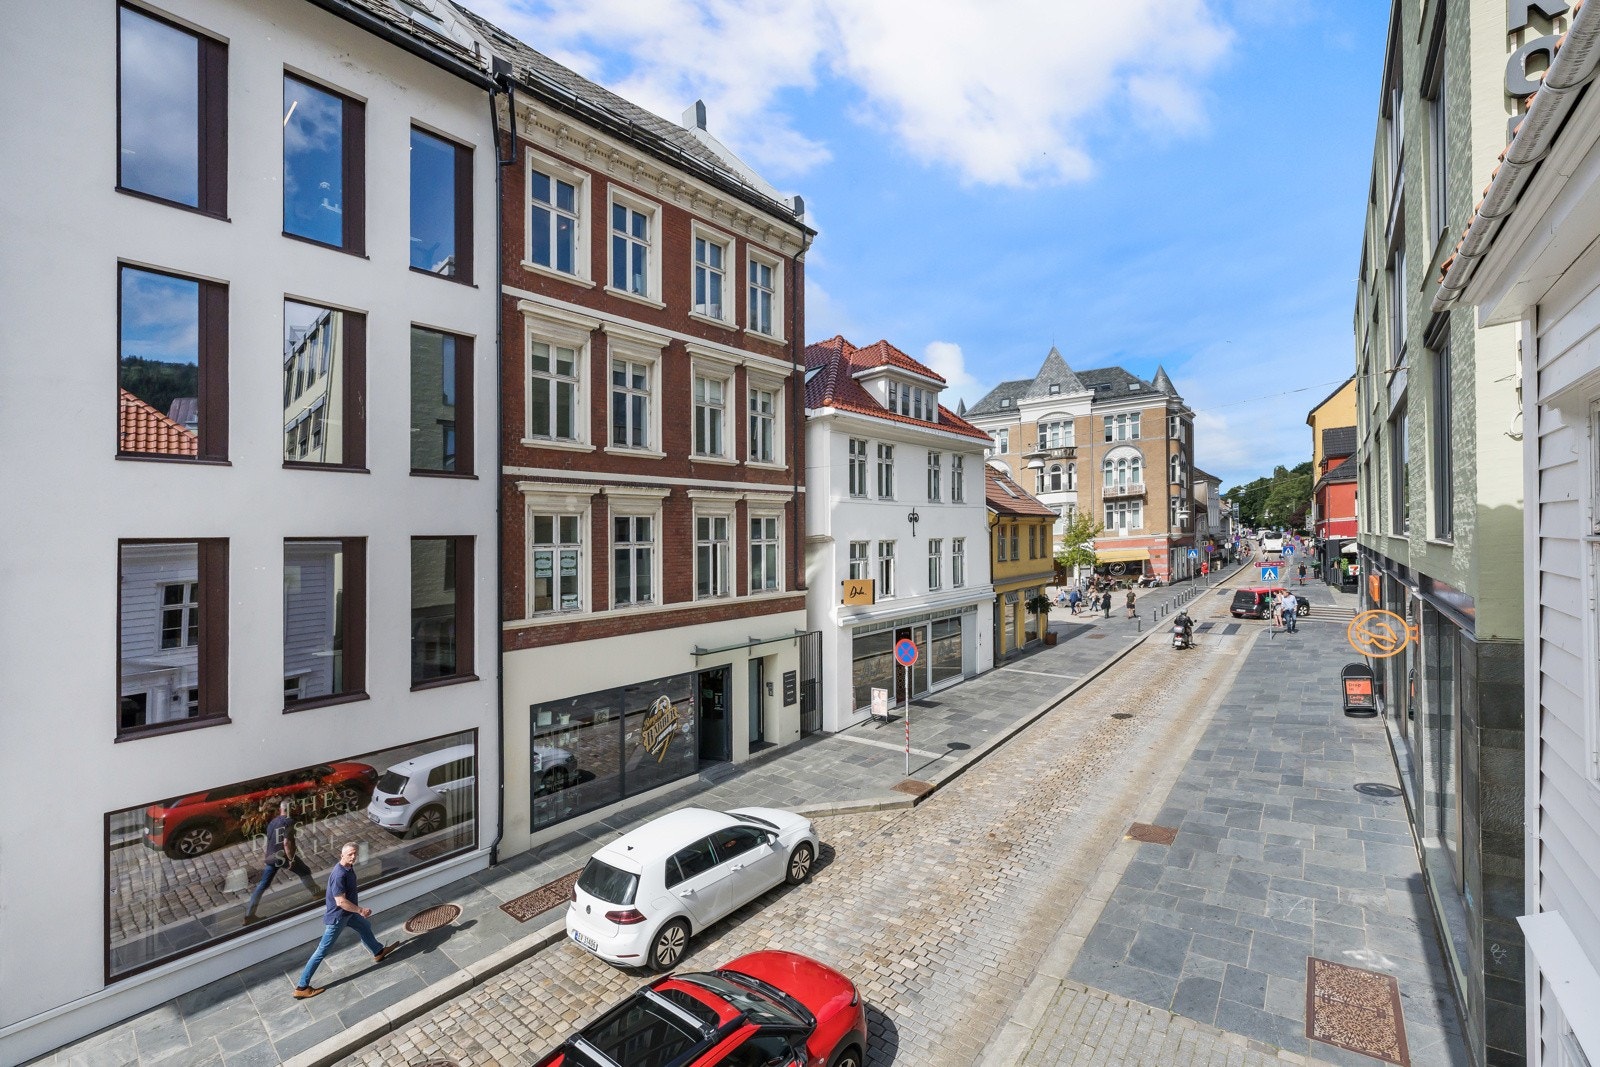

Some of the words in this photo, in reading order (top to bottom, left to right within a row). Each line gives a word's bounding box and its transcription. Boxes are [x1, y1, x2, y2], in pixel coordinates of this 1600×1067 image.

[644, 706, 677, 750] BARBER
[286, 791, 335, 818] THE
[251, 804, 359, 850] DESIGN
